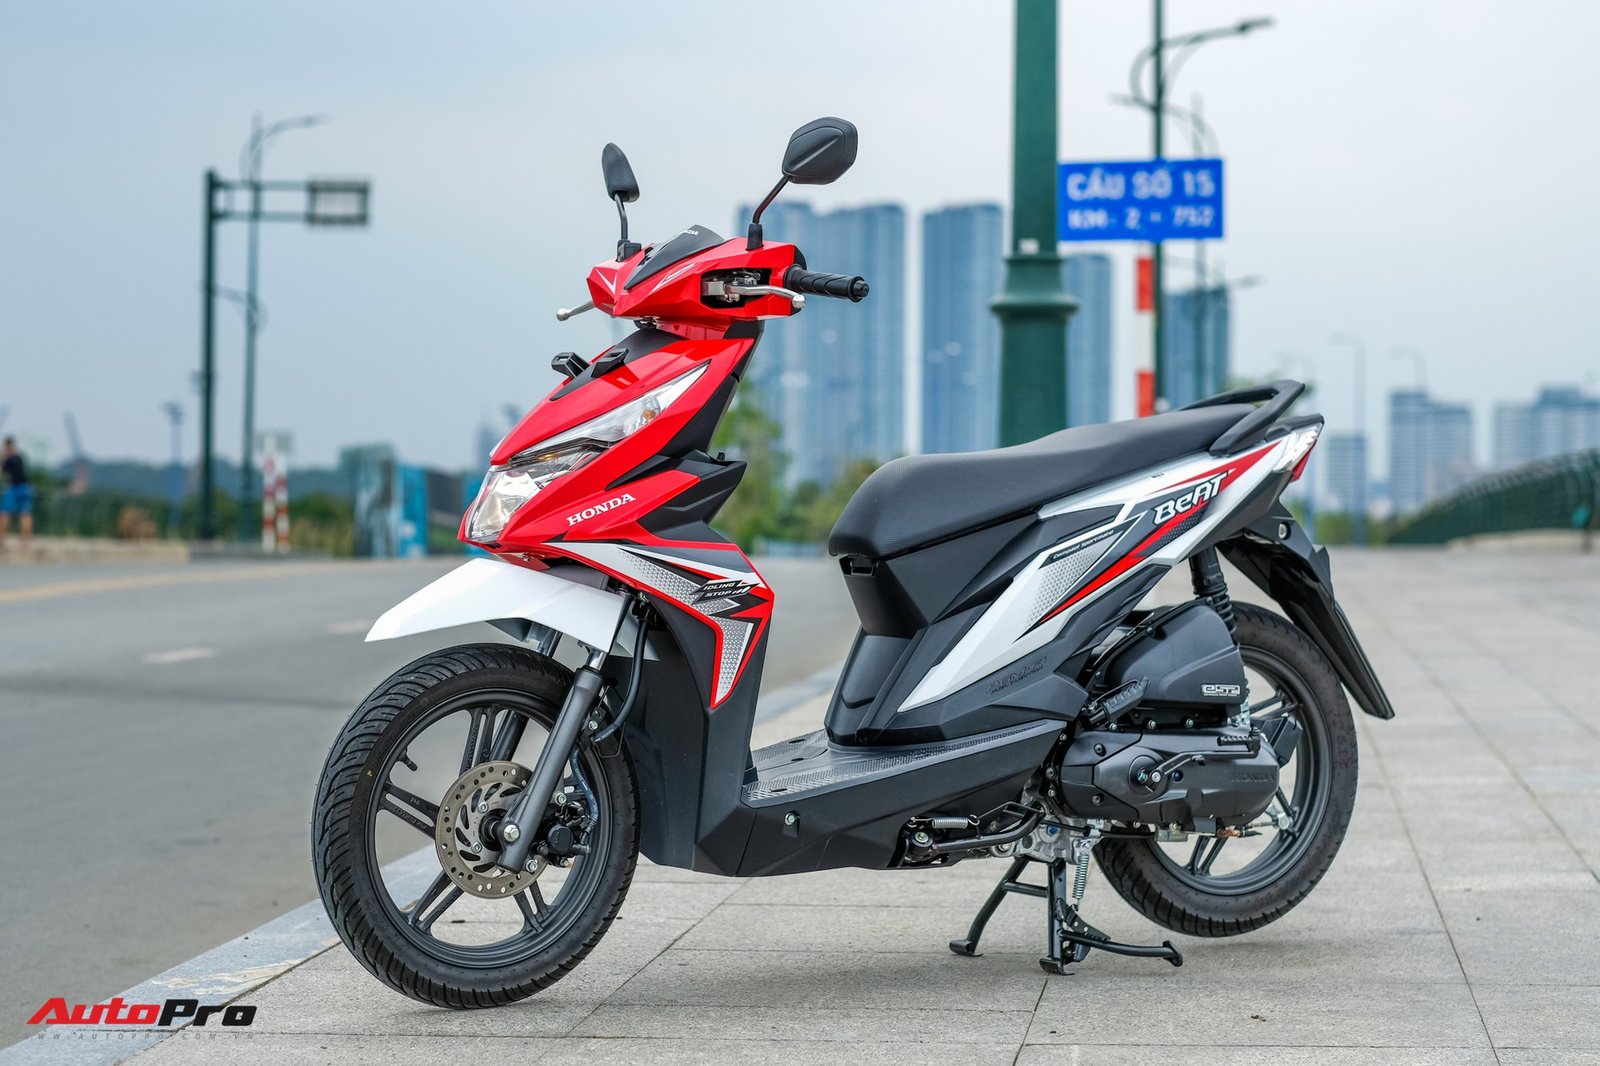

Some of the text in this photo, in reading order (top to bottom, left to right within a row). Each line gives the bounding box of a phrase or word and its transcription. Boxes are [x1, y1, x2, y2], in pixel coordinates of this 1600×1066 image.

[1183, 169, 1215, 197] 15
[566, 493, 636, 527] HONDA
[702, 582, 736, 591] IDLING
[704, 590, 732, 598] STOP
